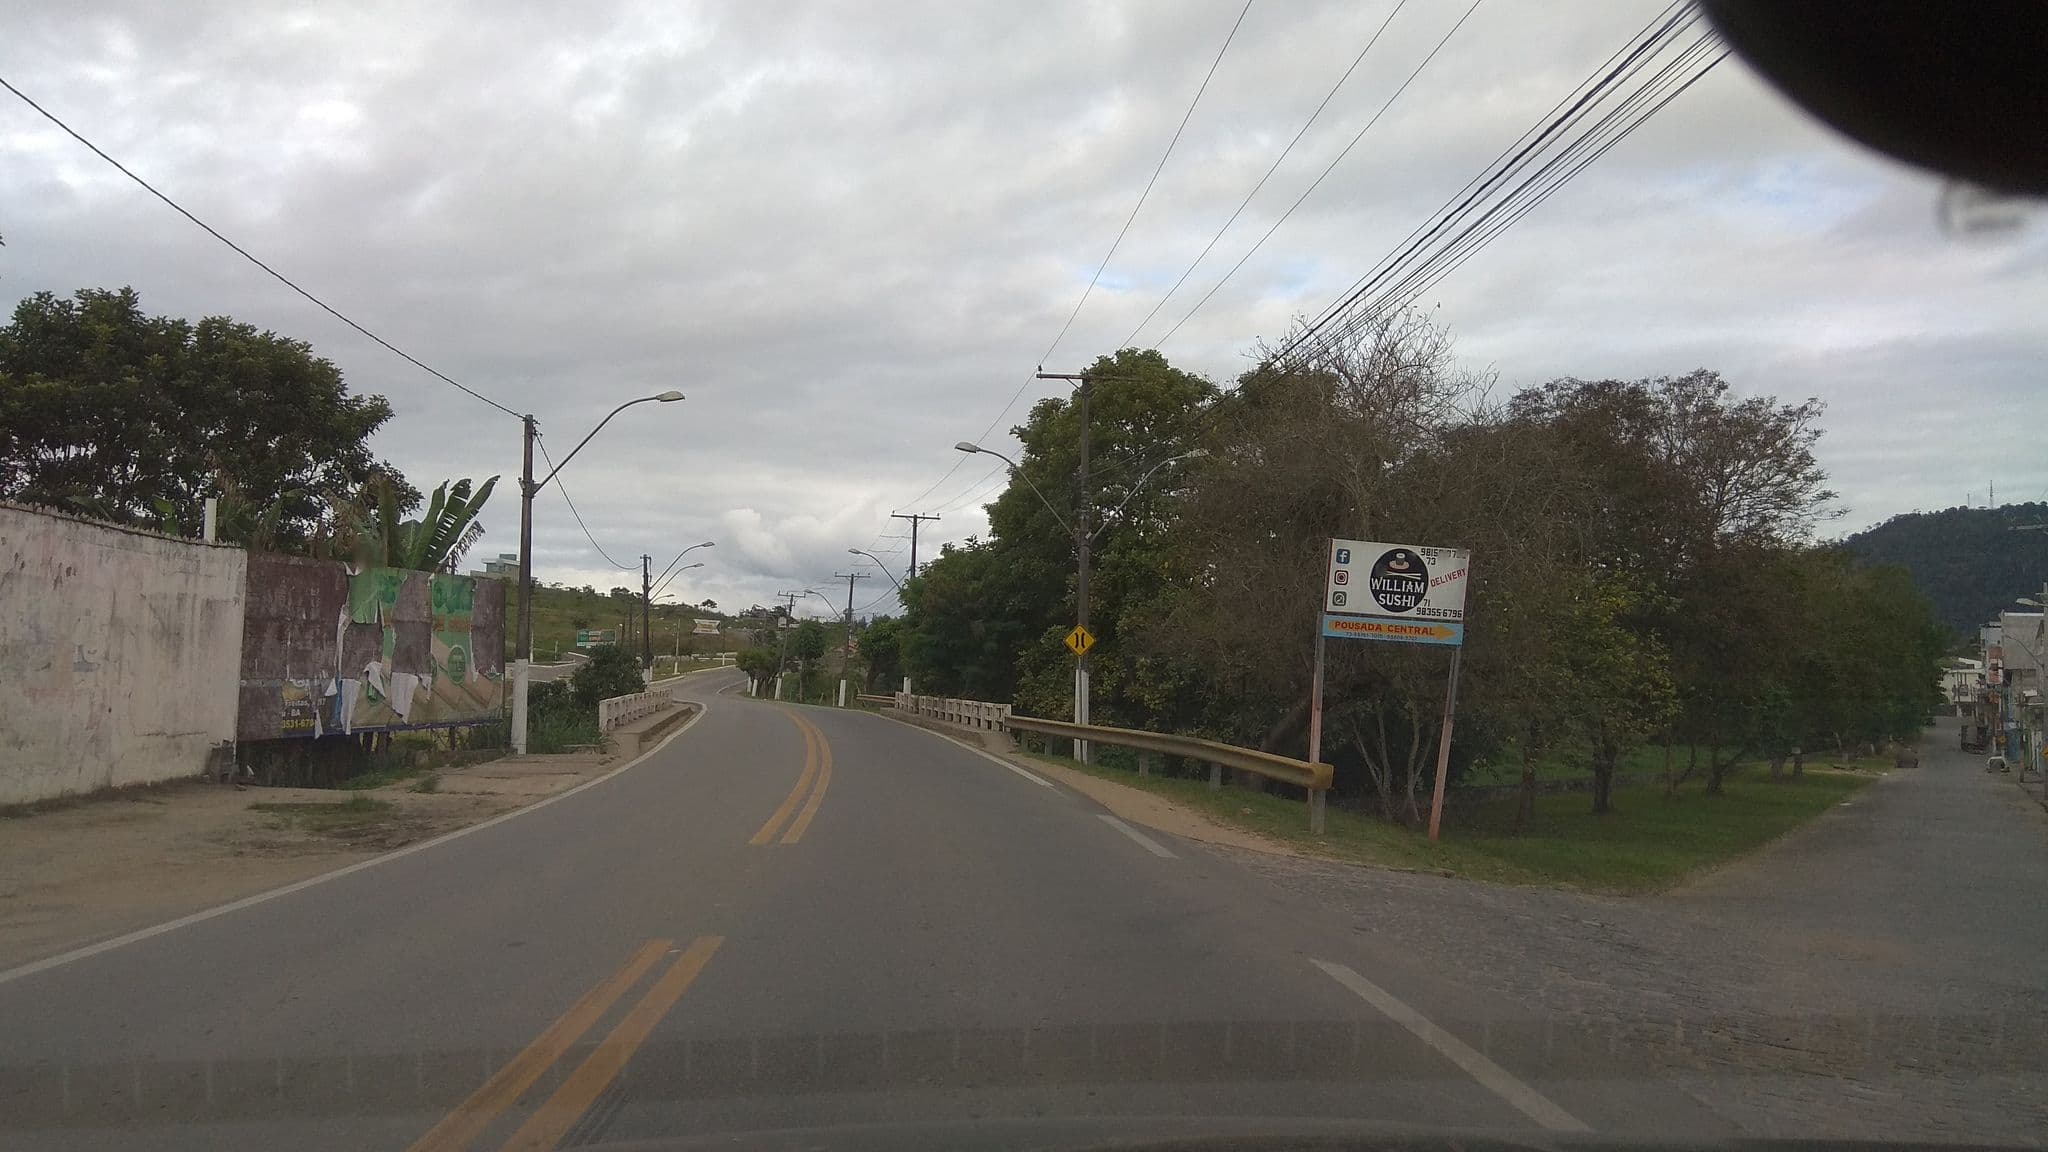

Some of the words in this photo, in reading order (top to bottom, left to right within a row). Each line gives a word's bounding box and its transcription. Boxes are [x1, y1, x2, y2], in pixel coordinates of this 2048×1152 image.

[1426, 557, 1436, 565] 73
[1430, 568, 1466, 587] DELIVERY
[1370, 577, 1425, 594] WILLIAM
[1378, 593, 1415, 608] SUSHI
[1423, 598, 1431, 607] 71
[1334, 620, 1383, 632] POUSADA
[1387, 623, 1435, 636] CENTRAL
